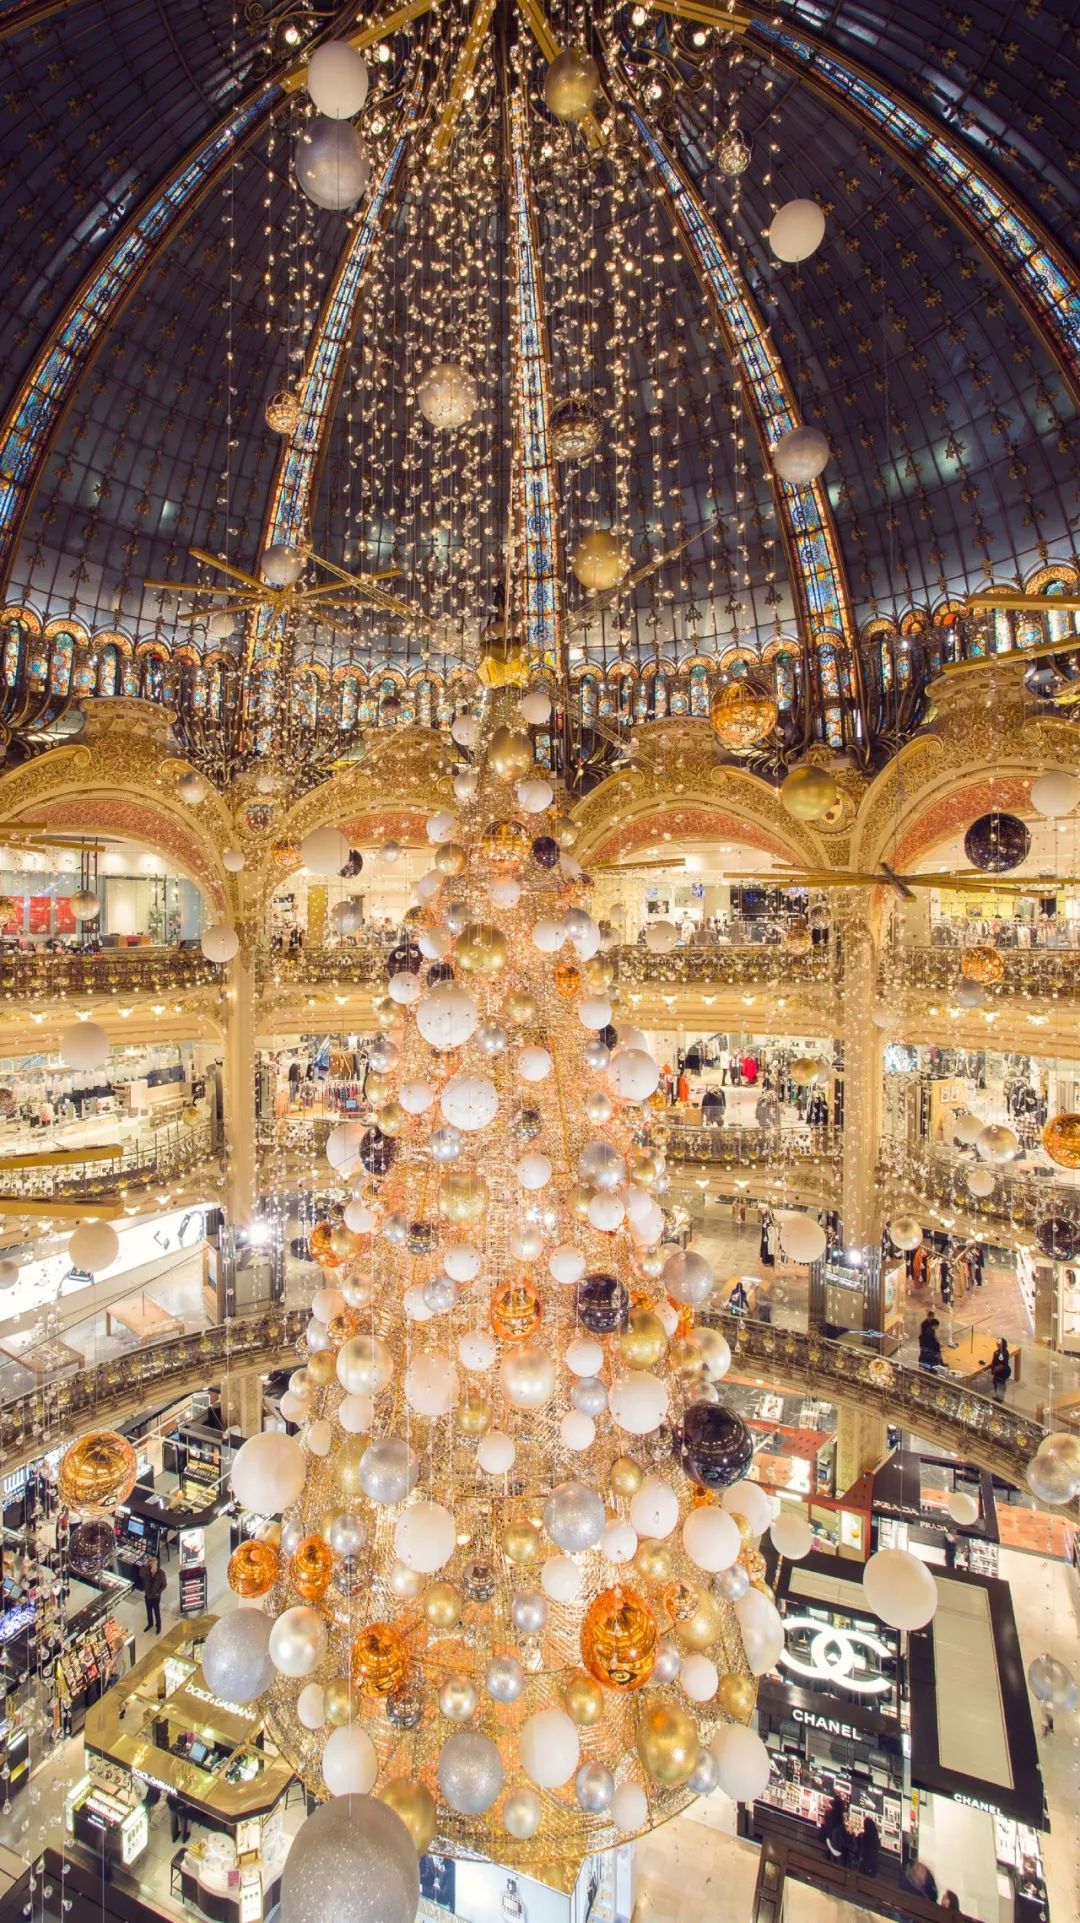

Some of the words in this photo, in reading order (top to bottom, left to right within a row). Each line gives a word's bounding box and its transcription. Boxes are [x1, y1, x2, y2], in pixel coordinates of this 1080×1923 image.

[873, 1500, 919, 1516] PRADA
[920, 1521, 948, 1532] PRADA
[792, 1709, 862, 1740] CHANEL
[953, 1793, 1004, 1817] CHANEL
